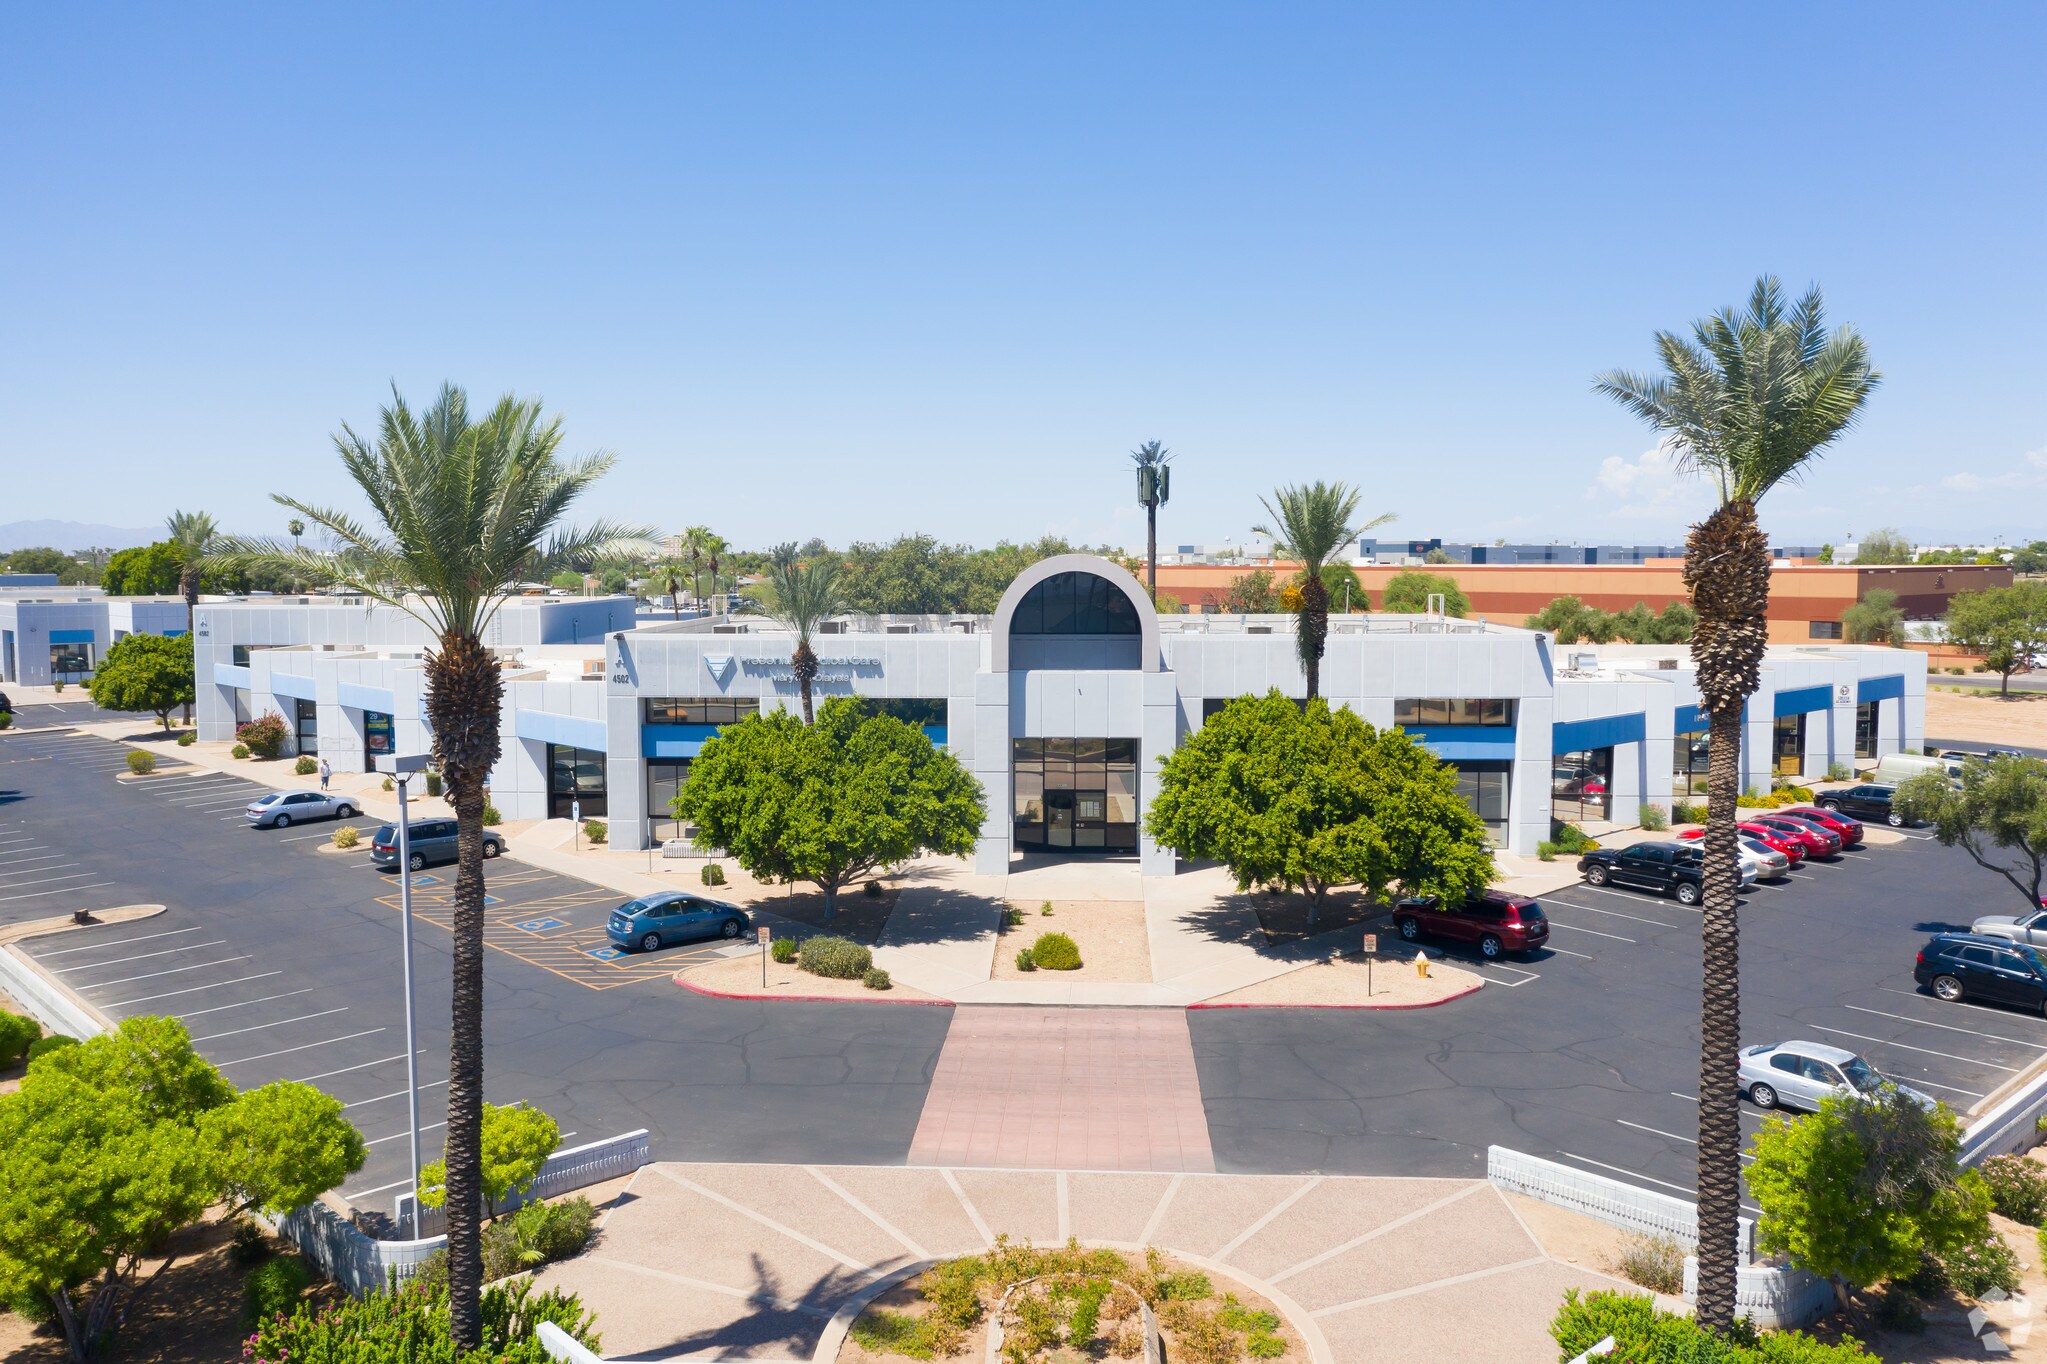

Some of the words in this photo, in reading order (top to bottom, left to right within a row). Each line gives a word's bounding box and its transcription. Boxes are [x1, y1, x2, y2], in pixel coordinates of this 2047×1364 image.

[739, 656, 791, 665] Freseniu
[850, 656, 880, 665] Care
[612, 674, 630, 684] 4502
